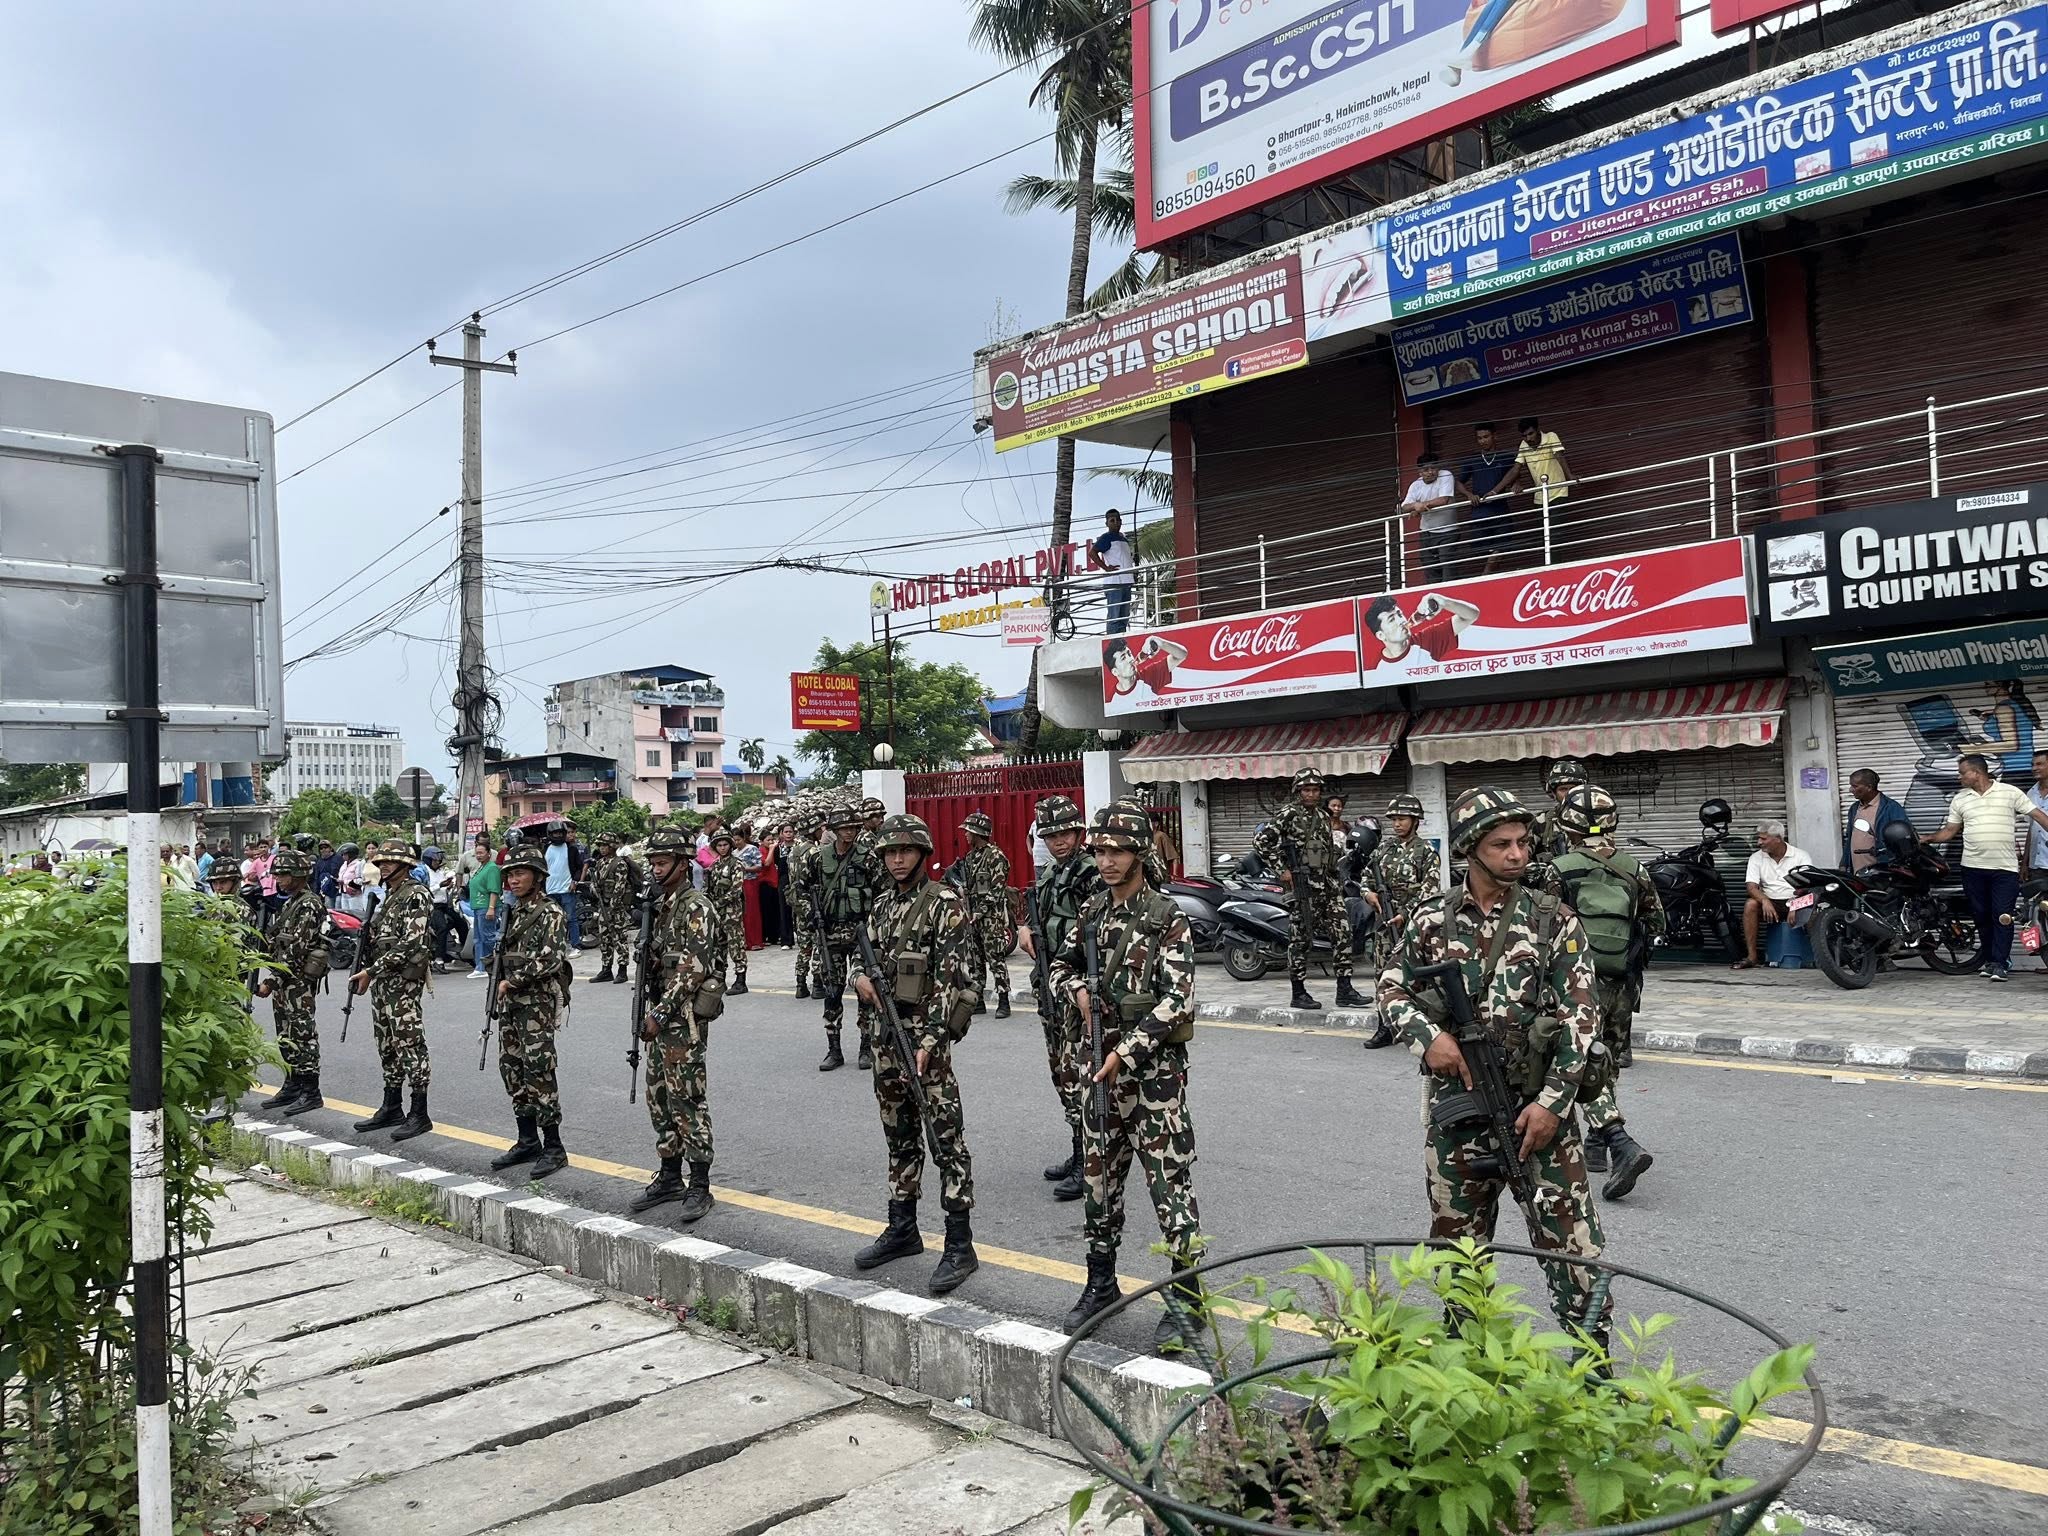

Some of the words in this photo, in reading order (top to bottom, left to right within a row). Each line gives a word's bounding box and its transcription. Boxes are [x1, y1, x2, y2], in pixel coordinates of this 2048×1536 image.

[1273, 17, 1318, 46] ADMISSION
[1201, 0, 1415, 123] B.Sc.CSIT
[1278, 113, 1334, 144] Bharatpur-9,
[1336, 86, 1400, 119] Hakimchowk,
[1403, 72, 1431, 92] Nepal
[1374, 92, 1421, 117] 9855051848
[1279, 121, 1384, 168] www.dreamscollege.edu.np
[1156, 164, 1255, 217] 9855094560
[1390, 197, 1507, 280] शुभकामना
[1512, 178, 1591, 234] डेण्टल
[1598, 150, 1655, 207] एण्ड
[1844, 61, 1938, 134] सेन्टर
[1550, 229, 1573, 242] Dr.
[1578, 207, 1643, 235] Jitendra
[1648, 189, 1706, 214] Kumar
[1710, 177, 1744, 195] Sah
[1702, 192, 1731, 206] M.D.S.
[1735, 202, 1761, 220] तथा
[1765, 194, 1792, 212] मुख
[1020, 322, 1112, 373] Kathmandu
[1113, 317, 1150, 341] BAKERY
[1150, 302, 1195, 328] BARISTA
[1195, 284, 1245, 313] TRAINING
[1245, 268, 1288, 298] CENTER
[1398, 329, 1464, 368] शुभकामना
[1465, 316, 1511, 345] डेण्टल
[1512, 306, 1543, 333] एण्ड
[1637, 267, 1685, 300] सेन्टर
[1502, 348, 1521, 361] Dr.
[1525, 332, 1578, 355] Jitendra
[1581, 317, 1627, 340] Kumar
[1631, 310, 1659, 327] Sah
[1020, 338, 1147, 407] BARISTA
[1152, 292, 1293, 364] SCHOOL
[1155, 361, 1178, 371] CLASS
[1179, 352, 1205, 365] SHIFTS
[1241, 351, 1271, 365] Kathmandu
[1272, 346, 1290, 359] Bakery
[1241, 363, 1260, 374] Barista
[1261, 358, 1283, 370] Training
[1283, 352, 1301, 363] Center
[1494, 359, 1530, 374] Consultant
[1531, 348, 1574, 364] Orthodontist
[1651, 322, 1673, 335] (K.U.)
[1026, 401, 1051, 411] COURSE
[1052, 392, 1077, 404] DETAILS
[893, 574, 952, 613] HOTEL
[954, 554, 1031, 599] GLOBAL
[1035, 542, 1083, 583] PVT.
[1512, 563, 1640, 623] Coca-Cola
[1842, 563, 2021, 610] EQUIPMENT
[1004, 623, 1049, 634] PARKING
[1209, 613, 1303, 662] Coca-Cola
[1443, 660, 1482, 674] ढकाल
[1513, 653, 1537, 667] एण्ड
[1541, 649, 1565, 666] जुस
[1569, 644, 1605, 660] पसल
[1886, 645, 1967, 674] Chitwan
[1967, 634, 2048, 667] Physical
[797, 675, 823, 689] HOTEL
[825, 676, 856, 690] GLOBAL
